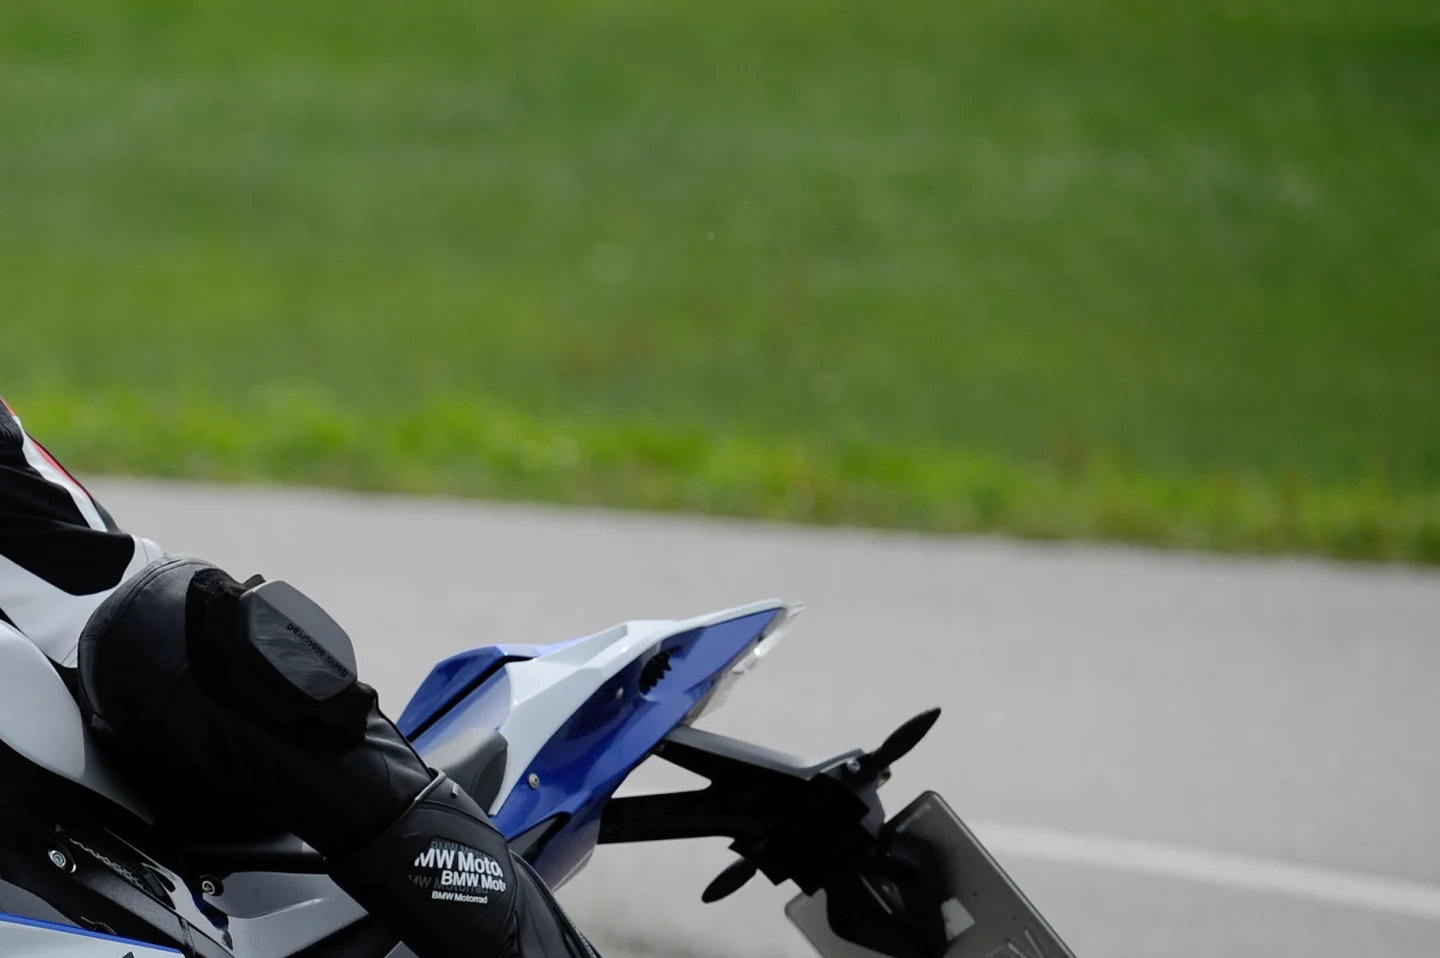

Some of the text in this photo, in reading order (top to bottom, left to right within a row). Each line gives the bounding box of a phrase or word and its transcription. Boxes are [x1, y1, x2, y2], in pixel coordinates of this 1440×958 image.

[286, 622, 348, 679] BMW Motorrad
[441, 870, 479, 888] BMW
[431, 890, 488, 904] BMW Motorrad
